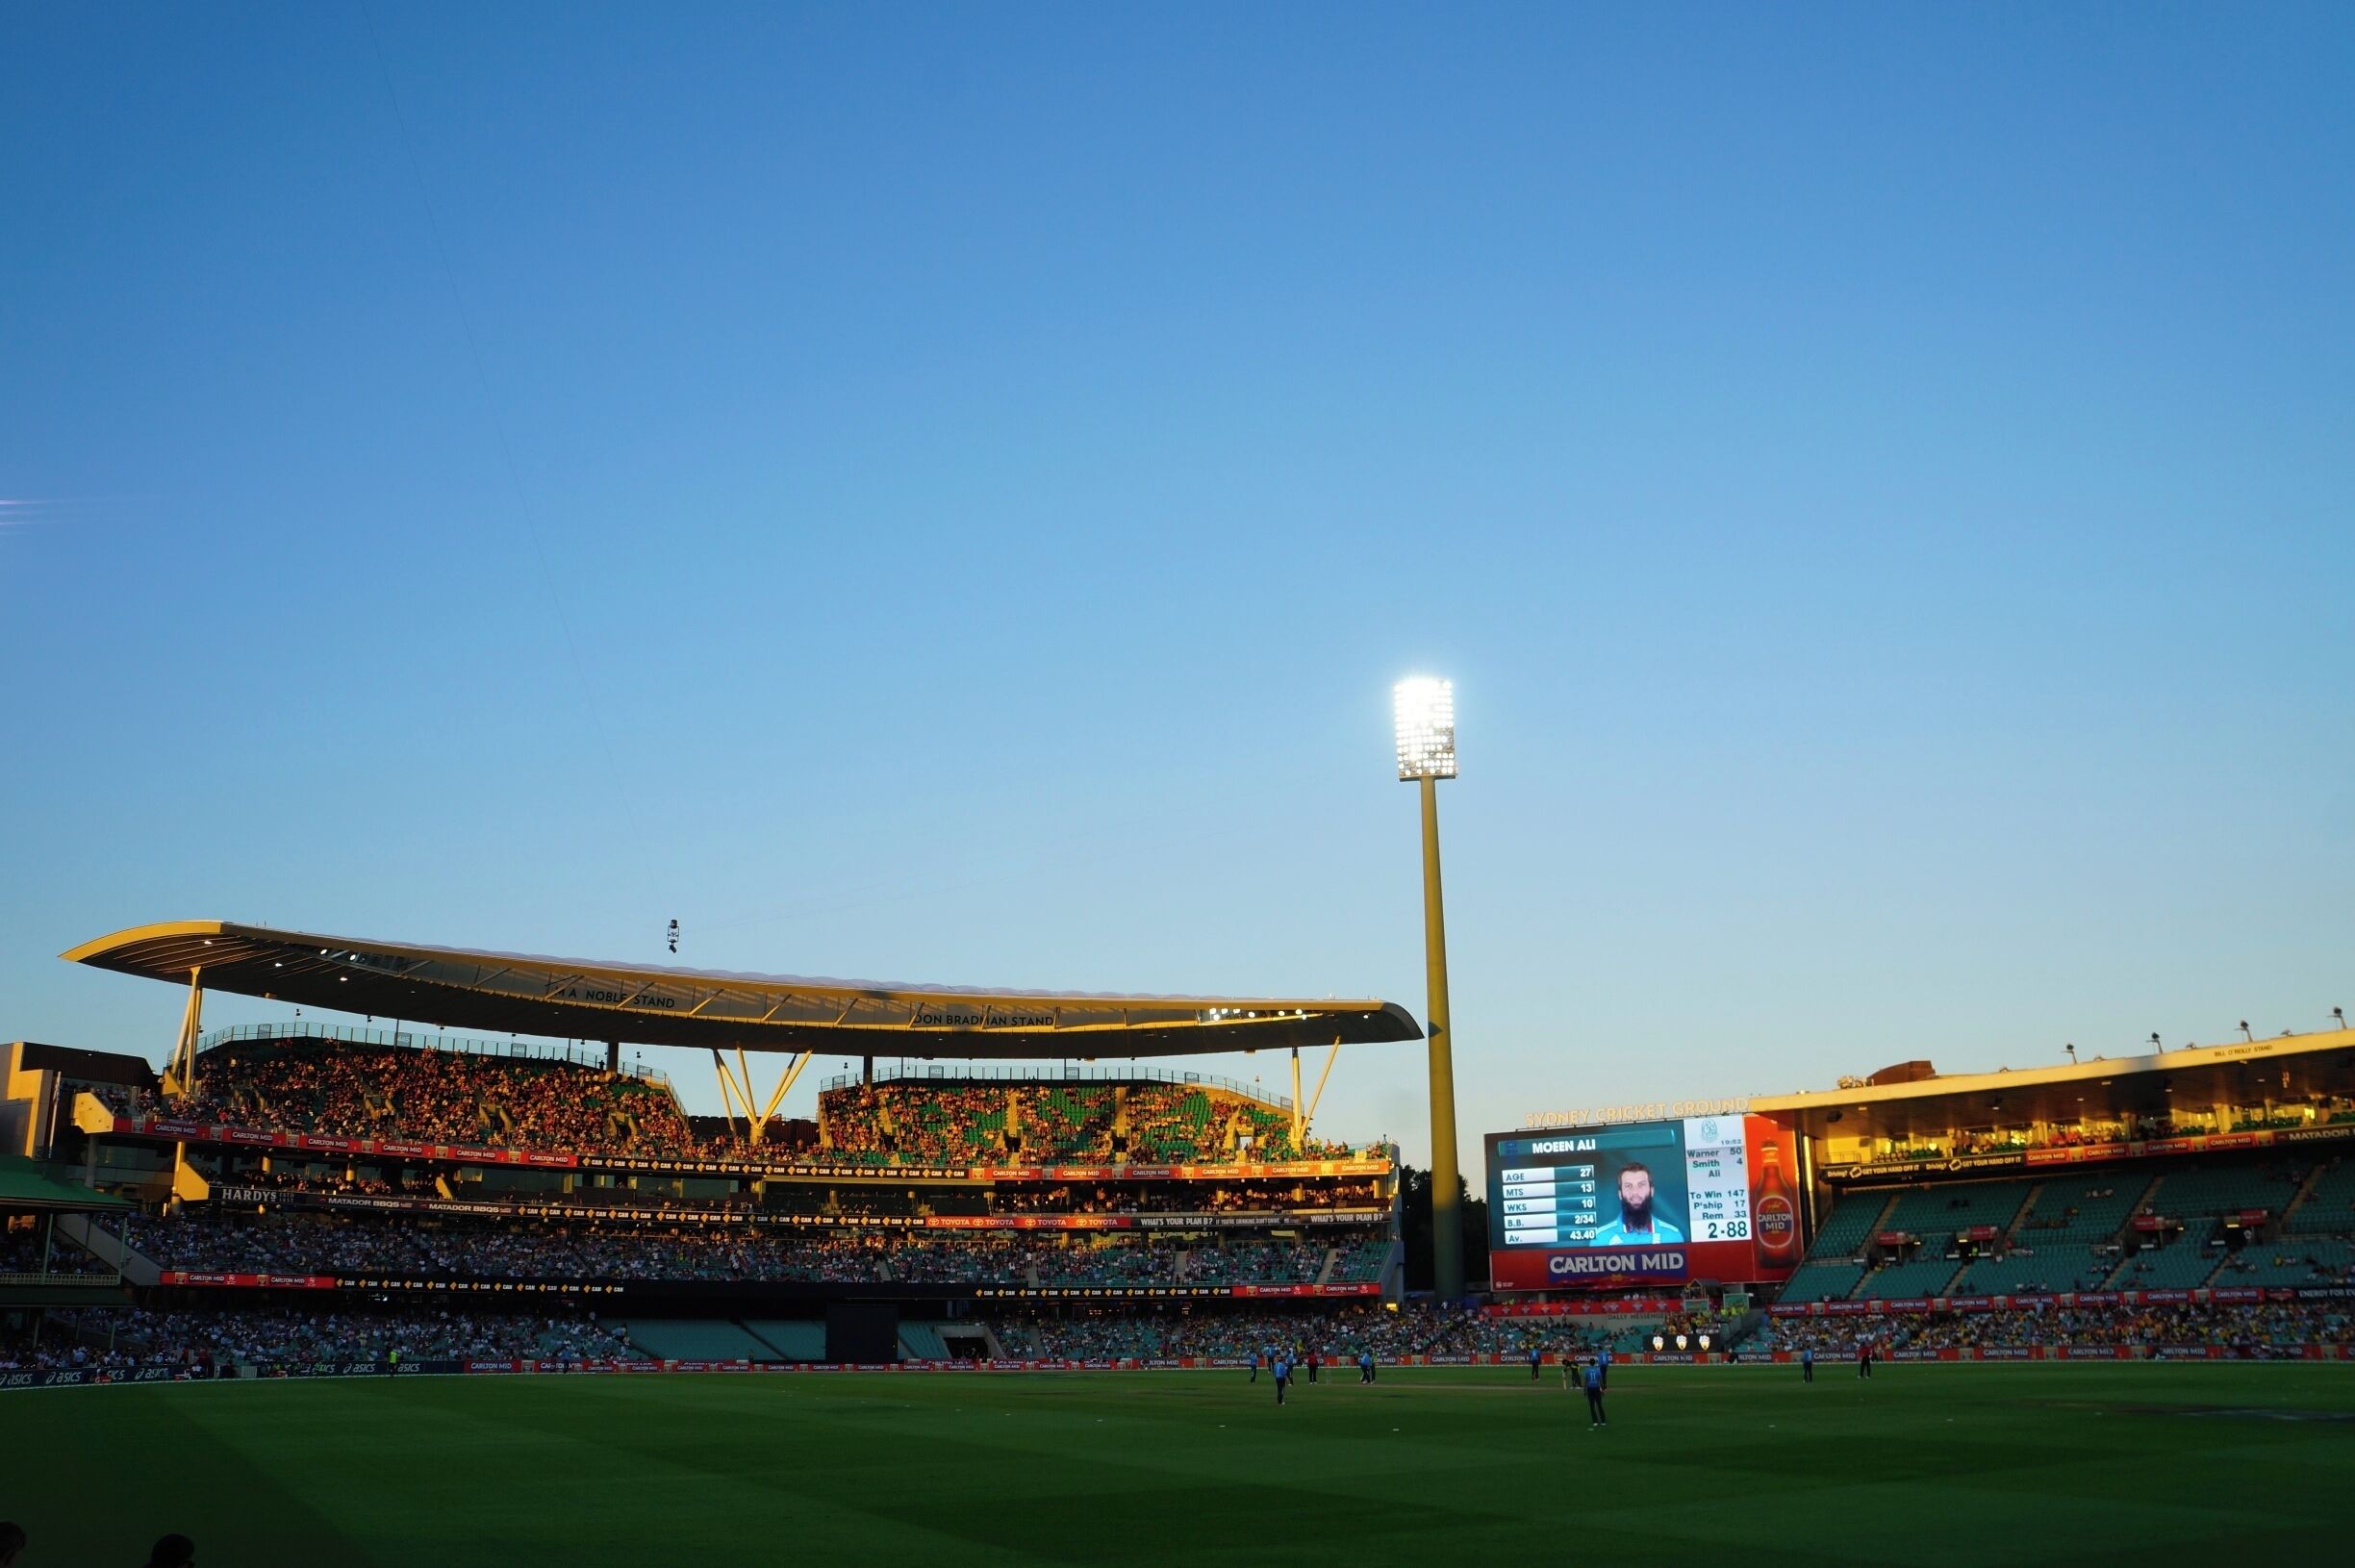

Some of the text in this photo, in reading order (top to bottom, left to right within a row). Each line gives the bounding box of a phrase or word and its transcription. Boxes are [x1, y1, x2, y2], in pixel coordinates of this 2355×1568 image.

[586, 990, 626, 1001] NOBLE
[634, 994, 674, 1007] STAND
[914, 1014, 1053, 1025] DON BRADMAN STAND
[1525, 1098, 1750, 1126] SYDNEY CRICKET GROUND
[155, 1125, 183, 1133] CARLTON
[232, 1131, 259, 1140] CARLTON
[2289, 1129, 2348, 1141] MATADOR
[308, 1138, 334, 1147] CARLTON
[1532, 1139, 1595, 1153] MOEEN ALI
[1687, 1149, 1719, 1158] Warner
[1692, 1159, 1720, 1168] Smith
[1926, 1162, 1947, 1171] Driving?
[1506, 1168, 1591, 1181] AGE 27
[1507, 1183, 1592, 1197] MTS 13
[1704, 1190, 1722, 1199] Win
[328, 1198, 371, 1206] MATADOR
[1507, 1199, 1593, 1212] WKS 10
[1694, 1201, 1723, 1210] P'ship
[1507, 1215, 1594, 1227] B.B. 2/34
[1702, 1211, 1724, 1220] Rem
[1758, 1213, 1791, 1224] CARLTON
[1765, 1222, 1785, 1231] MID
[1508, 1230, 1595, 1243] Av. 43.40
[1550, 1253, 1684, 1275] CARLTON MID
[2298, 1289, 2328, 1298] ENERGY
[353, 1362, 376, 1373] asics
[397, 1362, 420, 1372] asics
[8, 1373, 32, 1385] asics
[57, 1372, 82, 1383] asics
